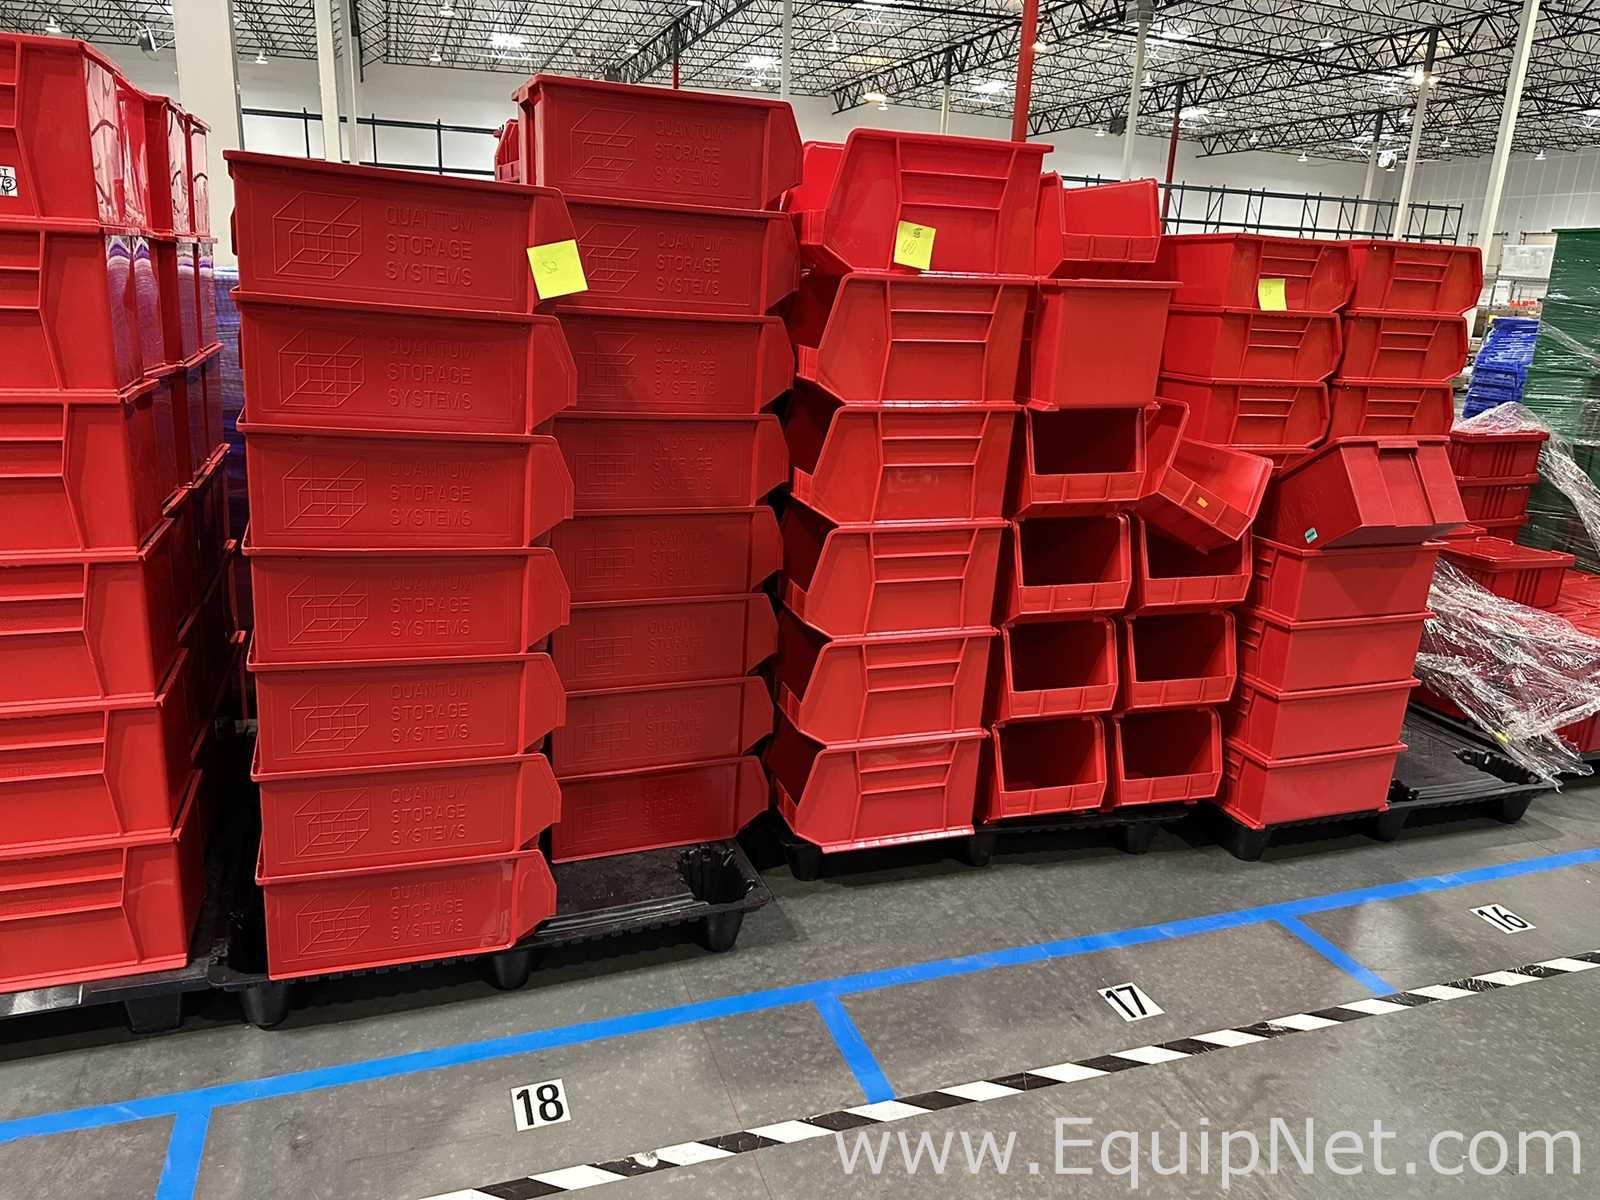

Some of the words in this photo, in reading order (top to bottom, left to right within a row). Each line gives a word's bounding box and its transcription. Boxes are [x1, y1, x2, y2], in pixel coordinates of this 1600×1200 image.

[654, 142, 721, 166] STORAGE
[653, 166, 720, 188] SYSTEMS
[384, 233, 473, 261] STORAGE
[384, 260, 473, 287] SYSTEMS
[655, 253, 721, 275] STORAGE
[655, 276, 720, 296] SYSTEMS
[386, 361, 473, 386] STORAGE
[386, 387, 473, 411] SYSTEMS
[388, 482, 473, 504] STORAGE
[388, 506, 473, 528] SYSTEMS
[389, 596, 473, 615] STORAGE
[389, 618, 473, 638] SYSTEMS
[390, 701, 472, 722] STORAGE
[390, 723, 472, 744] SYSTEMS
[390, 804, 467, 826] STORAGE
[390, 824, 466, 846] SYSTEMS
[390, 898, 465, 921] STORAGE
[1477, 906, 1528, 931] 16
[390, 917, 464, 941] SYSTEMS
[1105, 985, 1147, 1018] 17
[516, 1083, 565, 1126] 18
